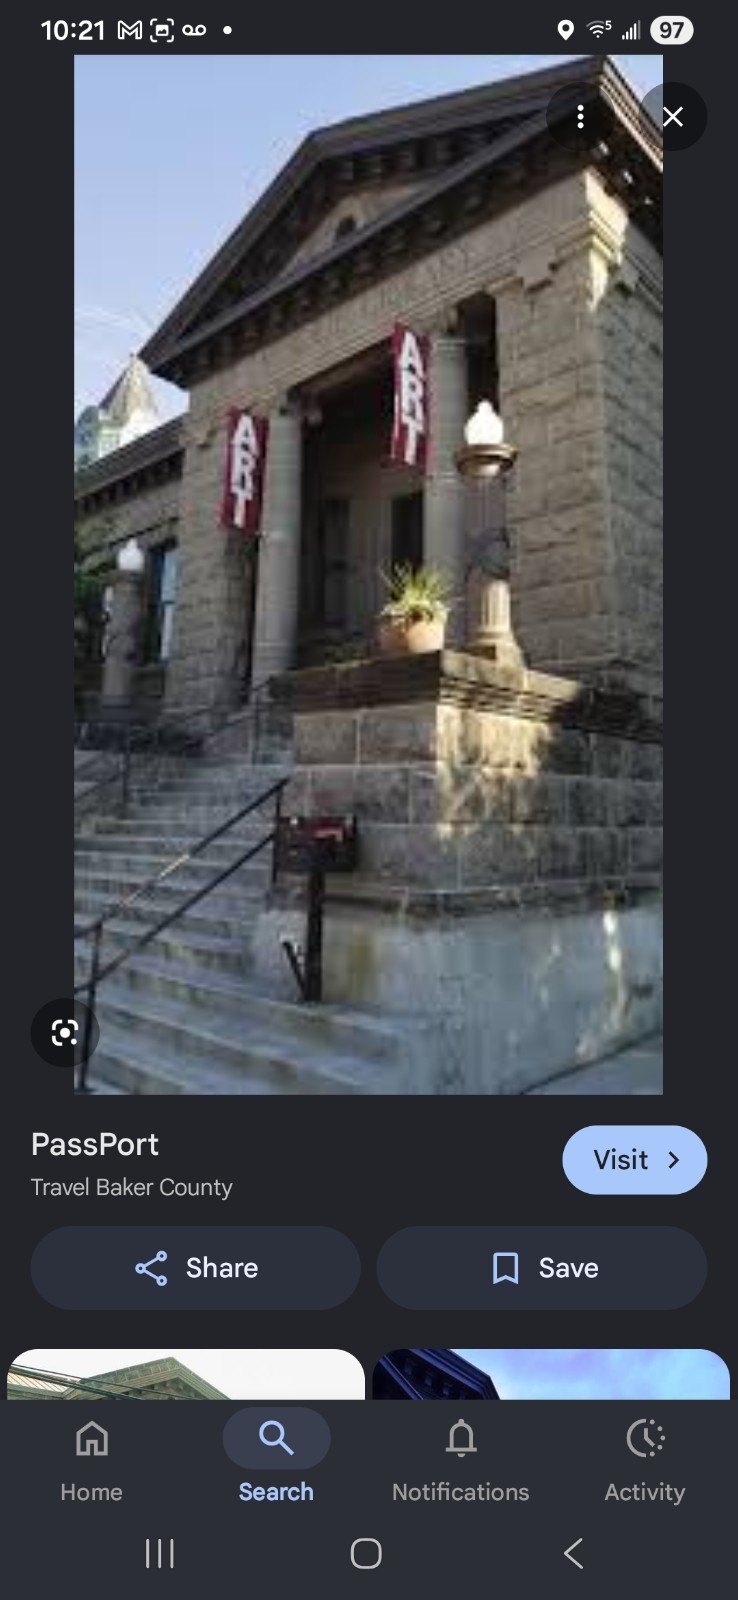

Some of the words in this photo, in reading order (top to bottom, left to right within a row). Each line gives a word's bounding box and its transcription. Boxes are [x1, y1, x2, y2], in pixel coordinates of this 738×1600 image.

[40, 20, 105, 40] 10:21
[604, 20, 613, 31] 5
[659, 21, 685, 39] 97
[401, 331, 424, 466] ART
[231, 414, 258, 528] ART
[31, 1132, 159, 1157] PassPort
[593, 1148, 649, 1171] Visit
[30, 1178, 90, 1197] Travel
[96, 1177, 155, 1197] Baker
[159, 1178, 233, 1202] County
[186, 1256, 259, 1279] Share
[539, 1256, 600, 1279] Save
[60, 1483, 123, 1502] Home
[238, 1482, 314, 1502] Search
[392, 1482, 530, 1502] Notifications
[604, 1482, 686, 1507] Activity
